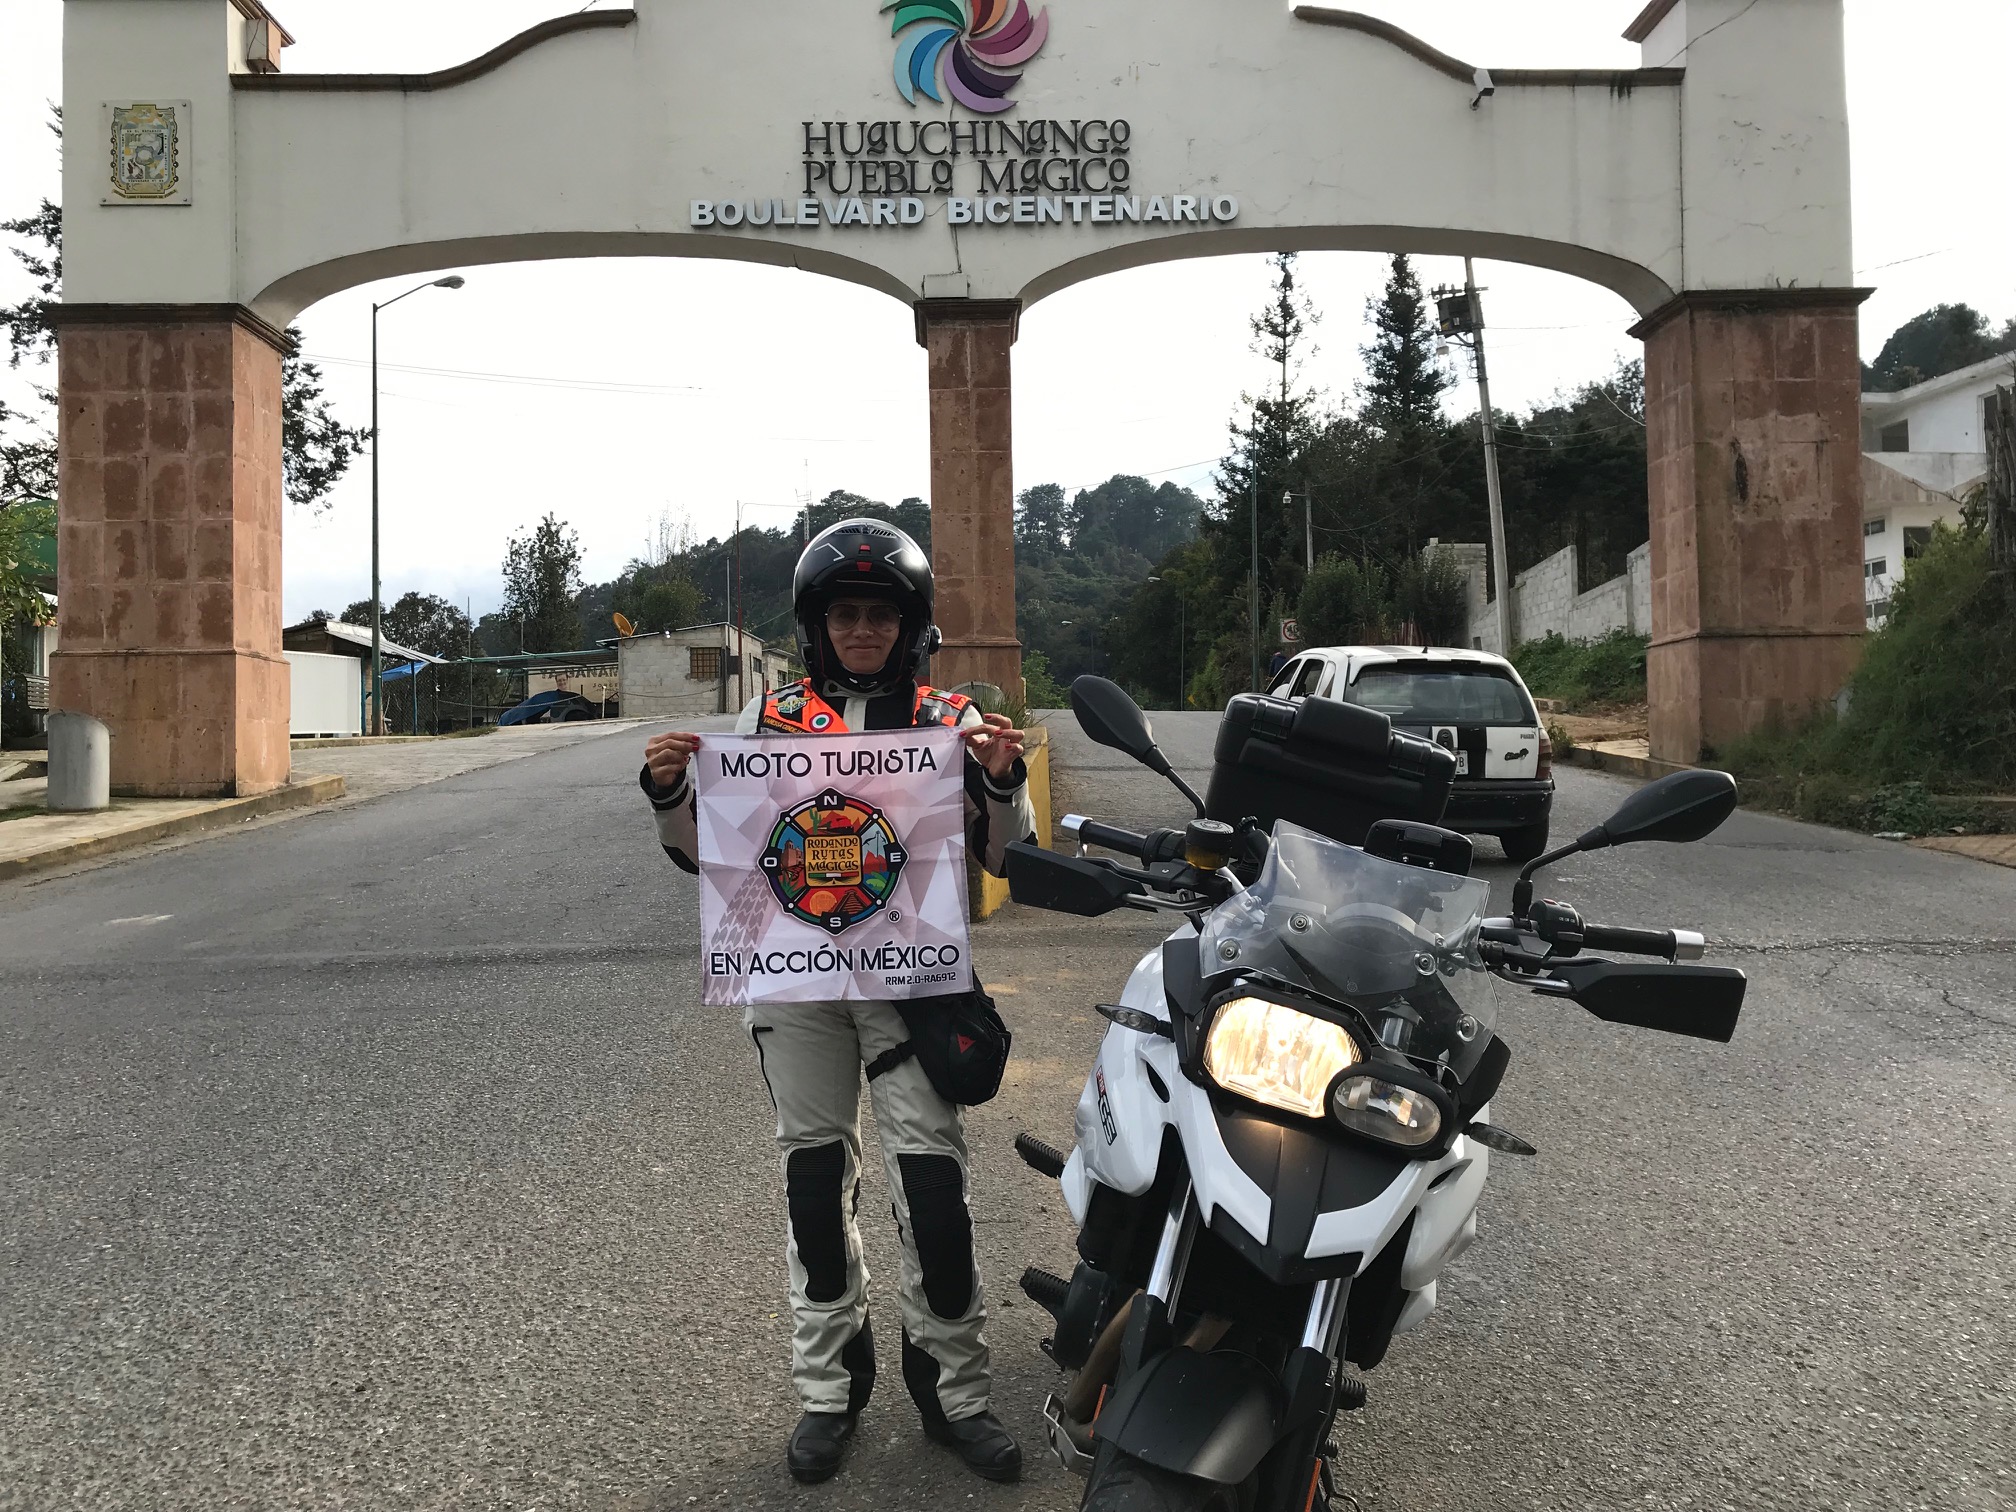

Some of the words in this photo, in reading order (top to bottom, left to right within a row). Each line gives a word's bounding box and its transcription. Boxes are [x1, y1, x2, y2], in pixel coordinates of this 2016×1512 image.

[802, 159, 954, 194] PUEBLO
[690, 197, 925, 227] BOULEVARD
[947, 194, 1239, 226] BICENTENARIO
[720, 752, 812, 778] MOTO
[820, 747, 938, 777] TURISTA
[823, 795, 838, 806] N
[764, 857, 778, 867] O
[890, 853, 901, 862] E
[829, 917, 842, 927] S
[710, 952, 742, 976] EN
[749, 943, 854, 975] ACCIÓN
[860, 941, 960, 971] MÉXICO
